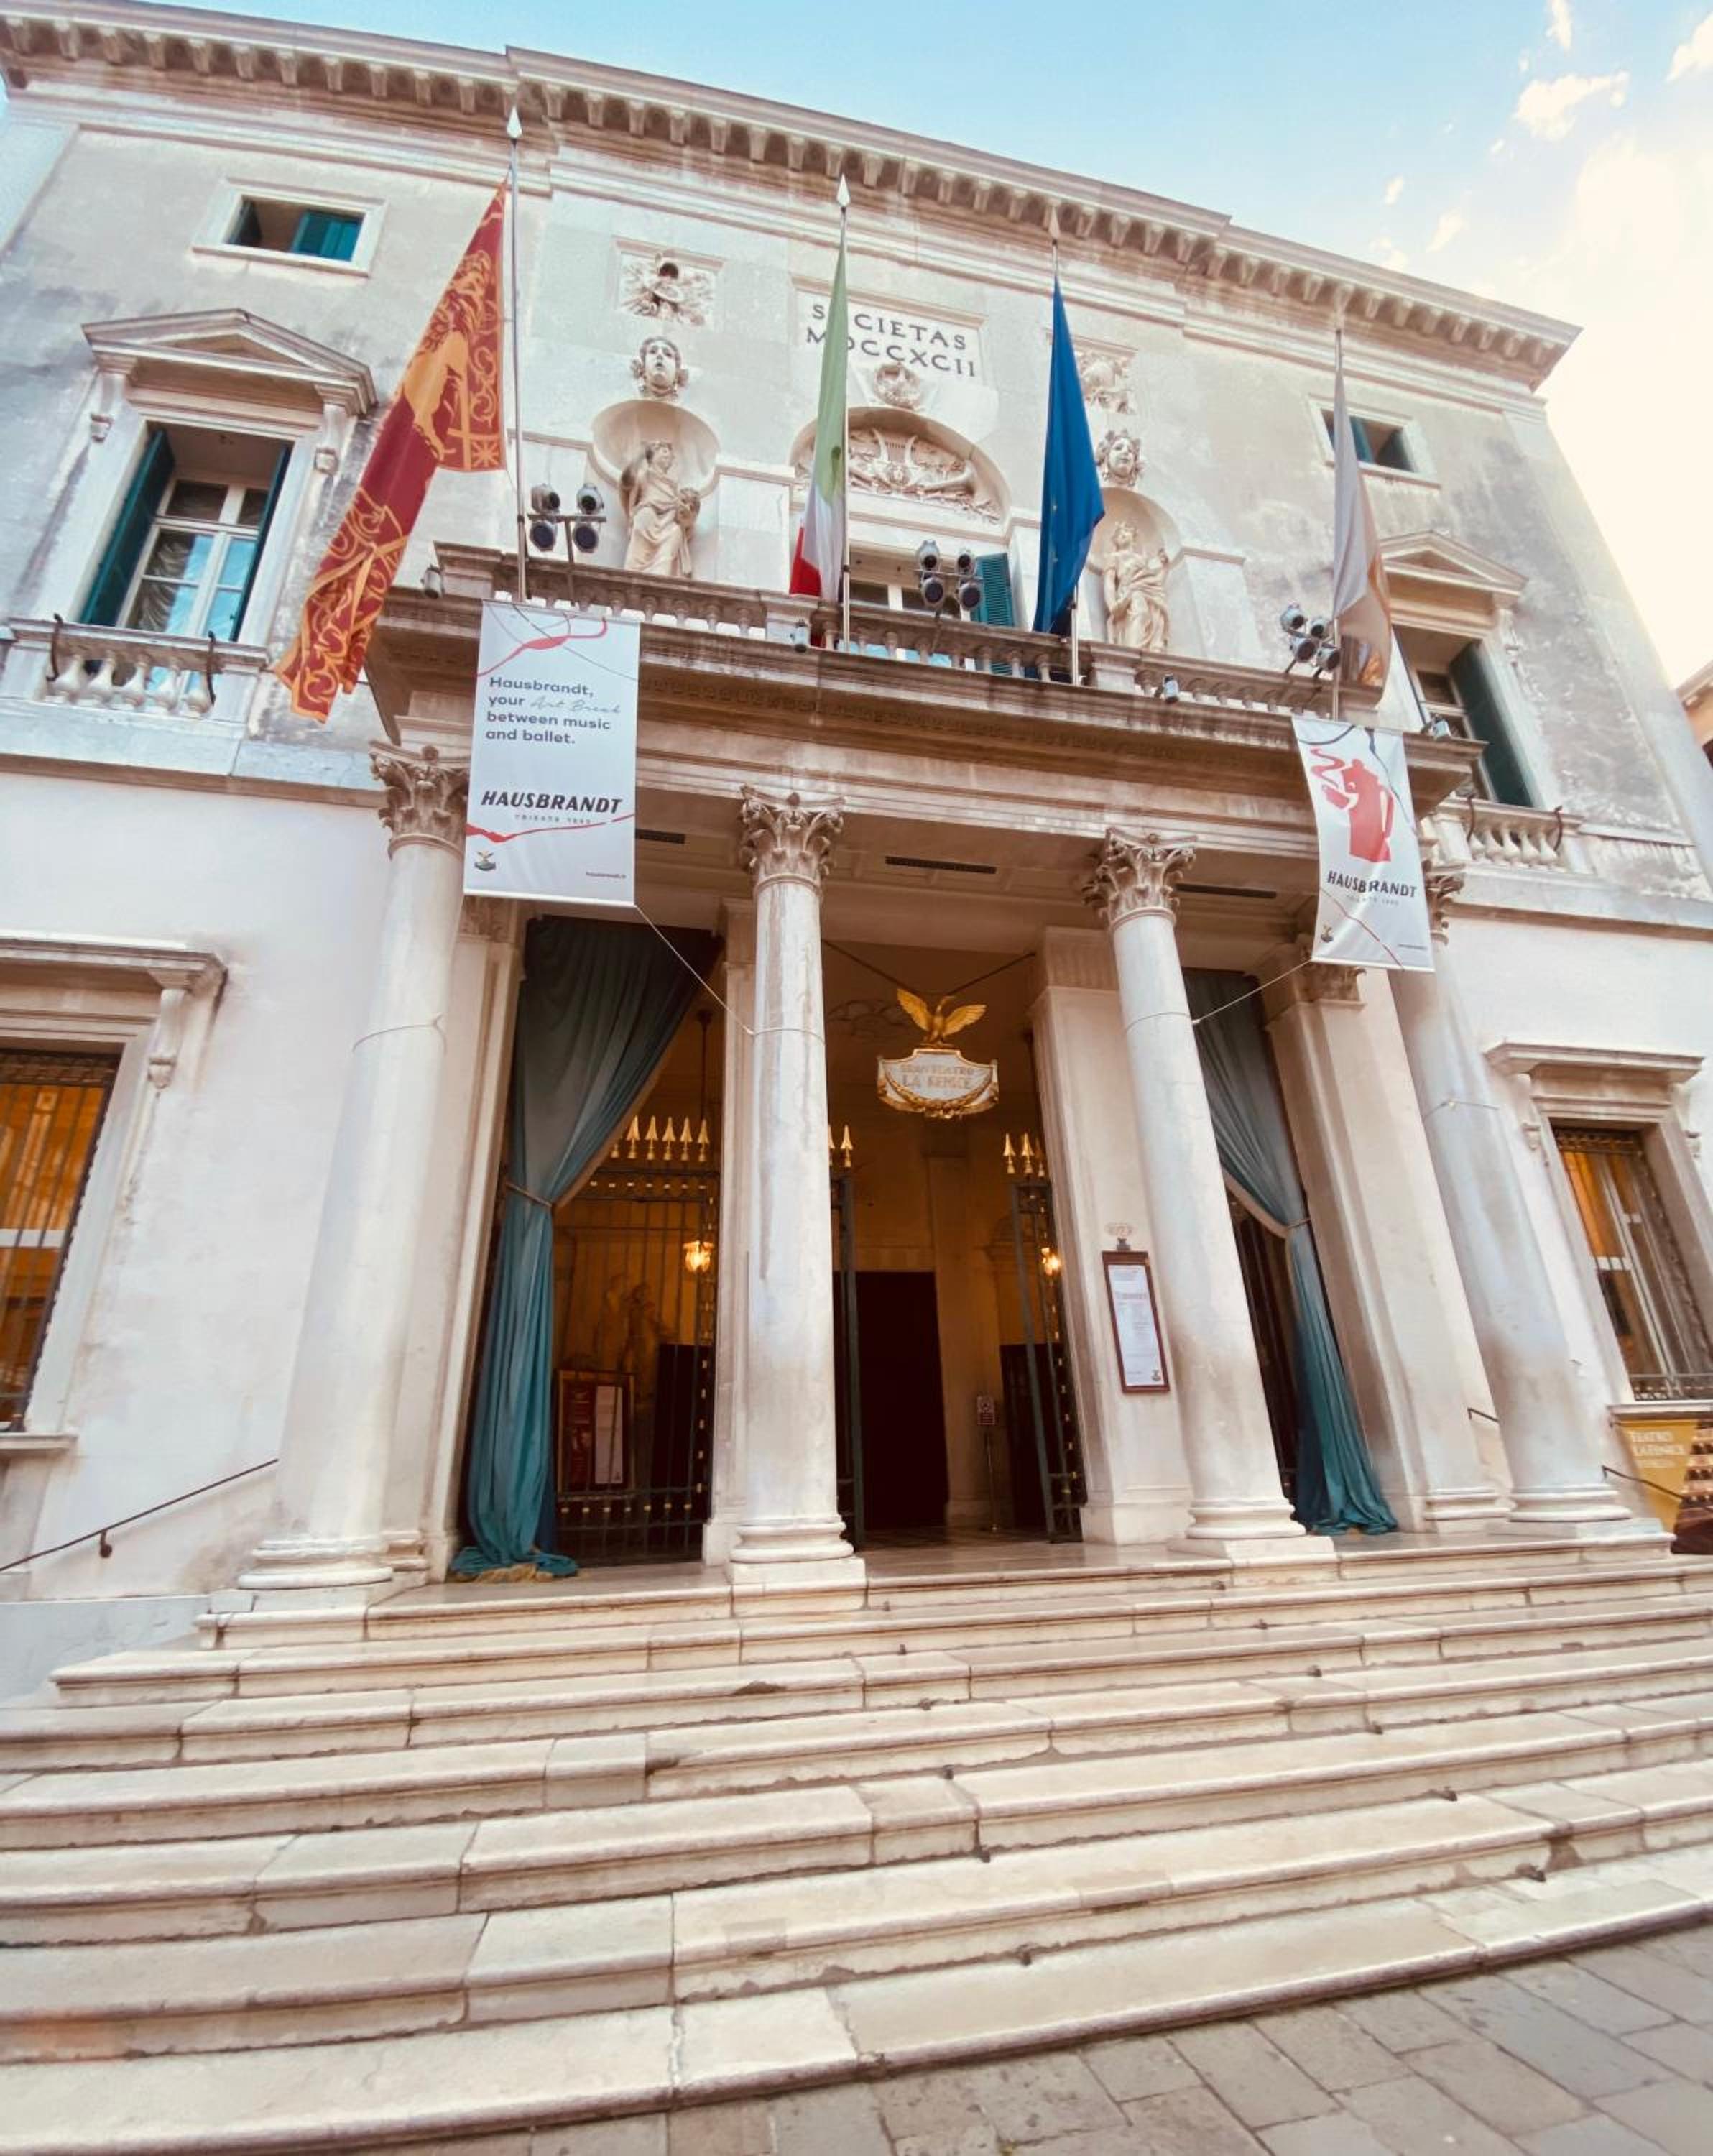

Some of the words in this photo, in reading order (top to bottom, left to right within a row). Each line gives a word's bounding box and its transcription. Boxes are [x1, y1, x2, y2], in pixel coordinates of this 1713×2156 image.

[812, 303, 966, 351] SCIETAS
[489, 676, 594, 698] Hausbrandt,
[489, 696, 525, 707] your
[530, 695, 565, 709] Art
[486, 711, 558, 725] between
[563, 717, 611, 730] music
[486, 729, 517, 740] and
[522, 729, 576, 745] ballet.
[481, 791, 623, 814] HAUSBRANDT
[1327, 870, 1418, 898] HAUSBRANDT
